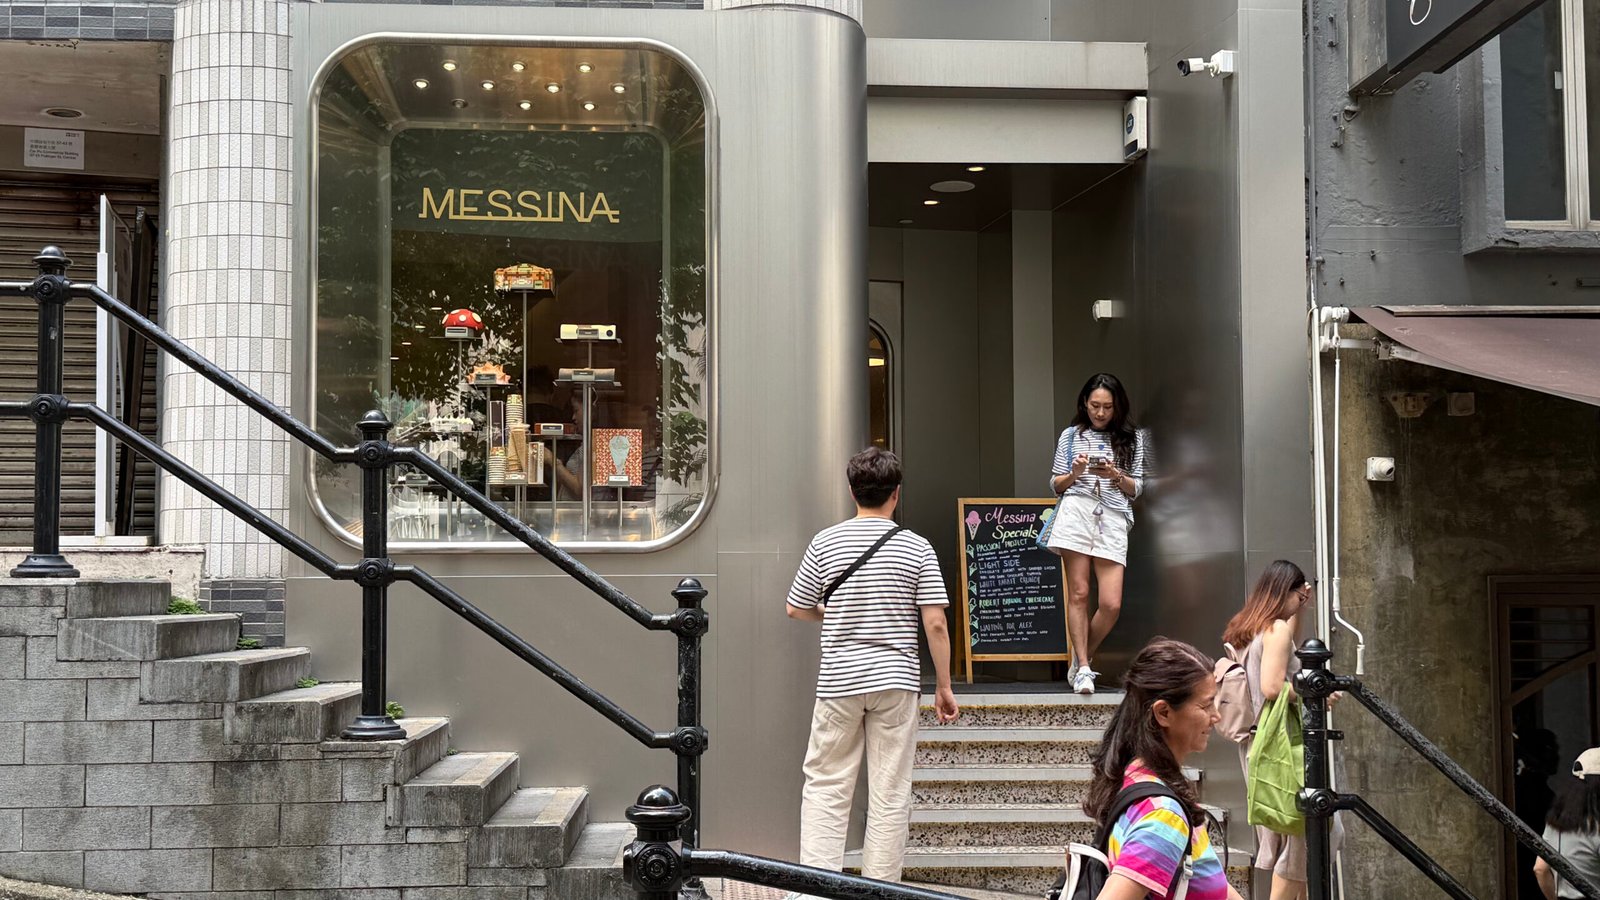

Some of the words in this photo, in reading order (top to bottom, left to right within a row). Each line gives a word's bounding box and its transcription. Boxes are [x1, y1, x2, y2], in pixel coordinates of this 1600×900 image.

[418, 187, 620, 223] MESSINA
[985, 507, 1036, 524] Messina
[992, 524, 1039, 543] Specials
[976, 541, 1000, 553] PASSION
[978, 560, 1001, 570] LIGHT
[1003, 559, 1020, 567] SIDE
[979, 598, 1000, 609] ROBERT
[1019, 621, 1033, 629] ALEX
